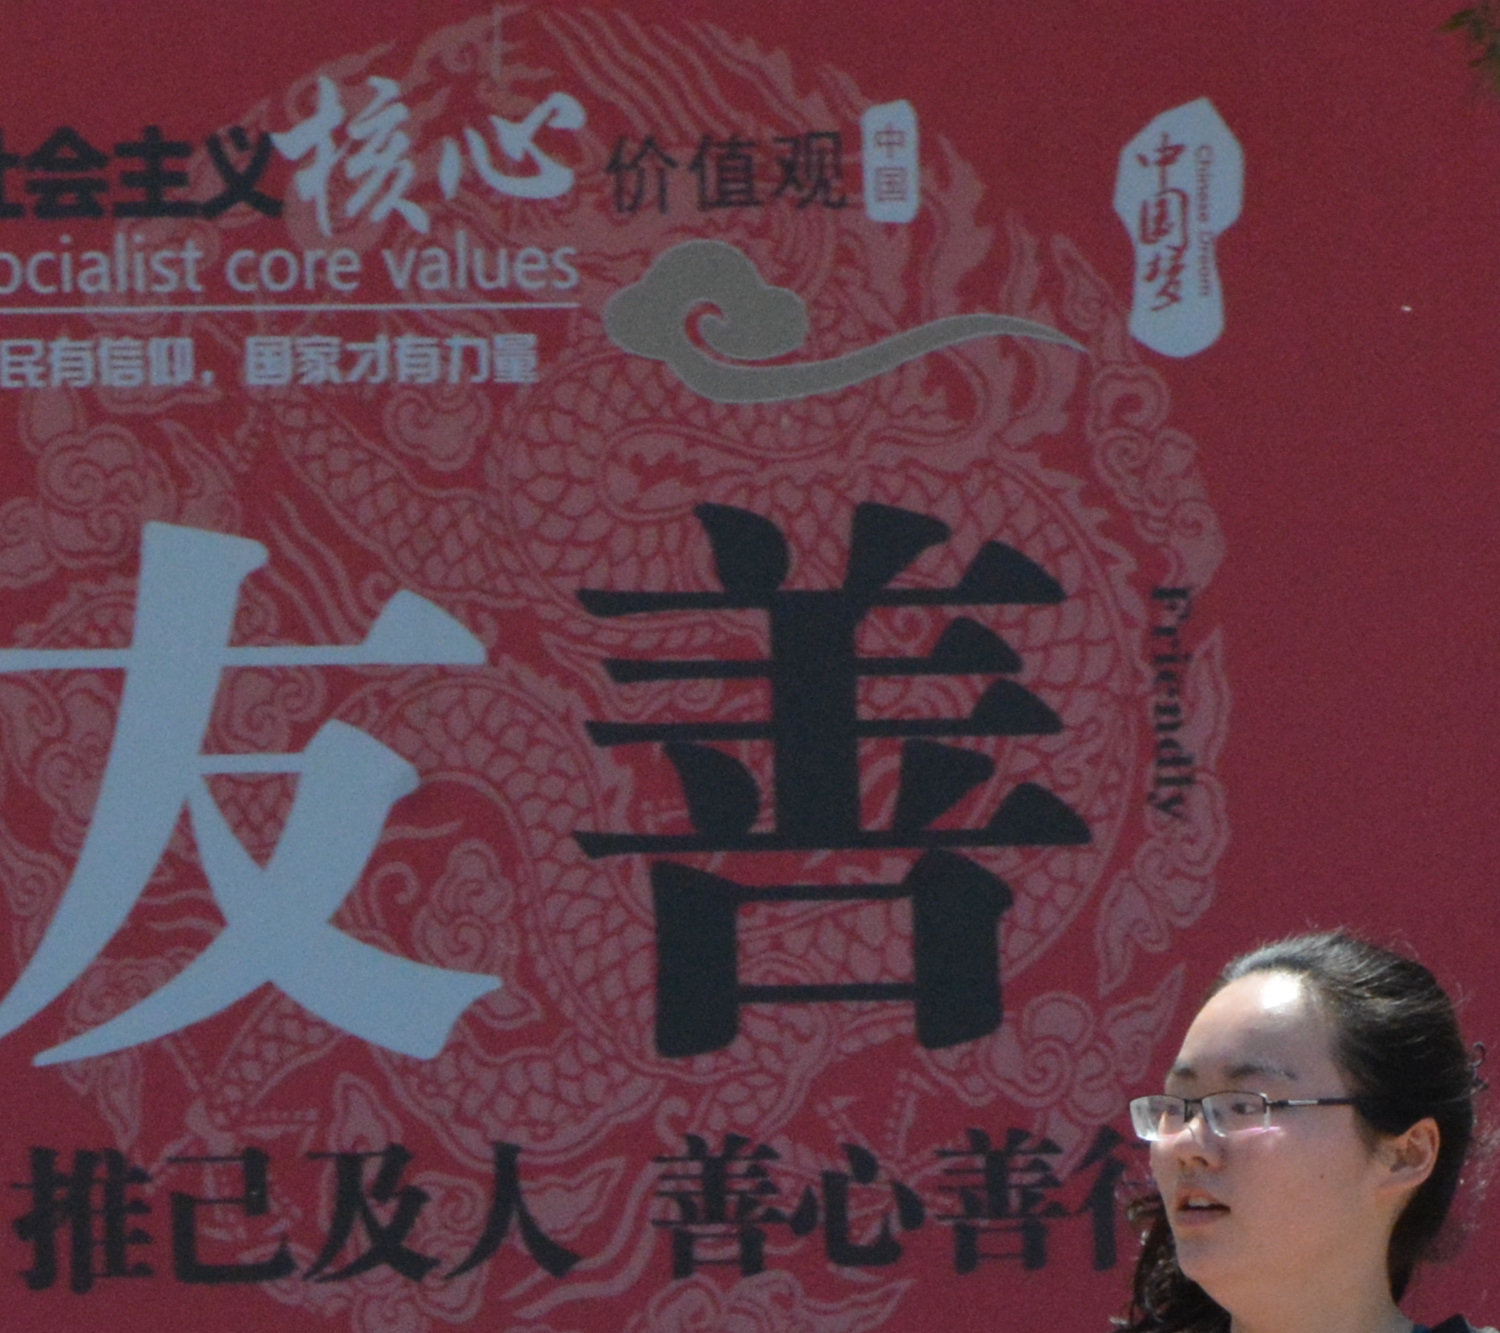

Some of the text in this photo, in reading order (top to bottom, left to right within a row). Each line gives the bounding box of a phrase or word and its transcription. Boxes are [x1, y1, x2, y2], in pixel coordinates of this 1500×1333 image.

[874, 122, 908, 202] 中国
[1136, 130, 1189, 312] 中国梦
[225, 247, 362, 293] core
[381, 229, 581, 291] values
[1147, 586, 1195, 821] Friendly
[10, 1140, 584, 1294] 推己及人
